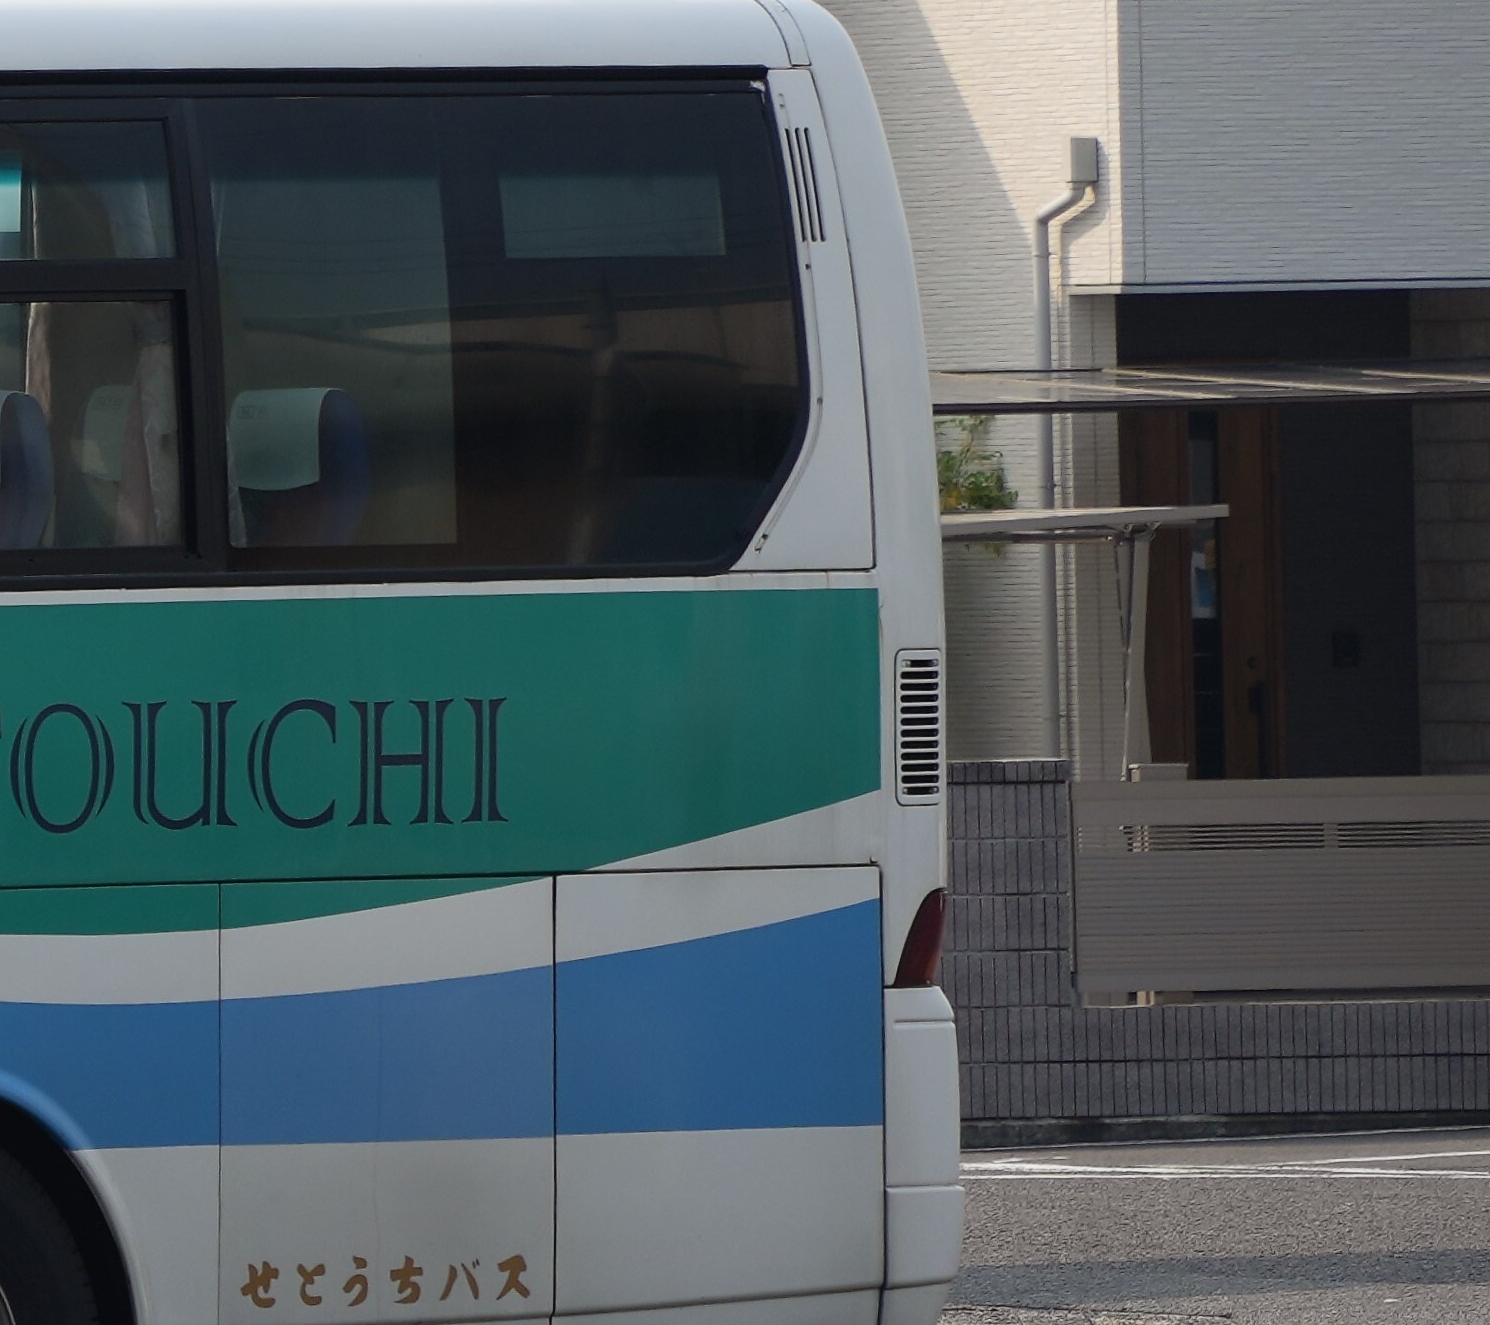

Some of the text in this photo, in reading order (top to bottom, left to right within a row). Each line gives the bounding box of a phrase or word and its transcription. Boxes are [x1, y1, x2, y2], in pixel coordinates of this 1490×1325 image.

[240, 1254, 530, 1308] せとうちバス
